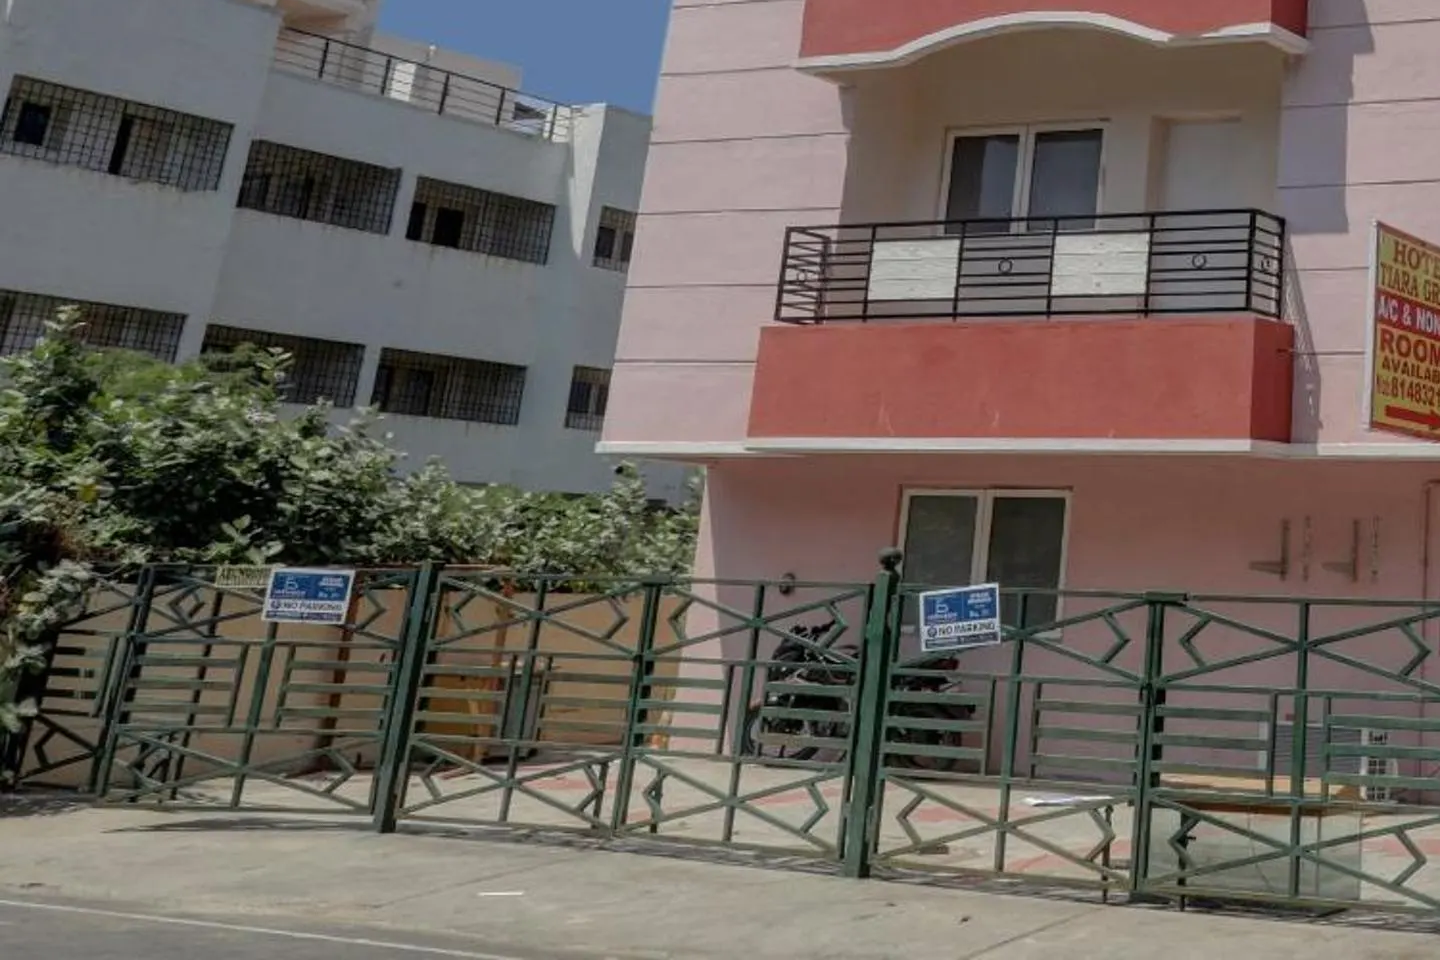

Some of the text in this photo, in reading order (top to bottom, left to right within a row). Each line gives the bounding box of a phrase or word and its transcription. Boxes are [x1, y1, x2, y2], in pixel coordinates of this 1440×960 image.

[1380, 261, 1419, 297] TIARA
[1402, 303, 1412, 326] &
[938, 625, 953, 636] NO
